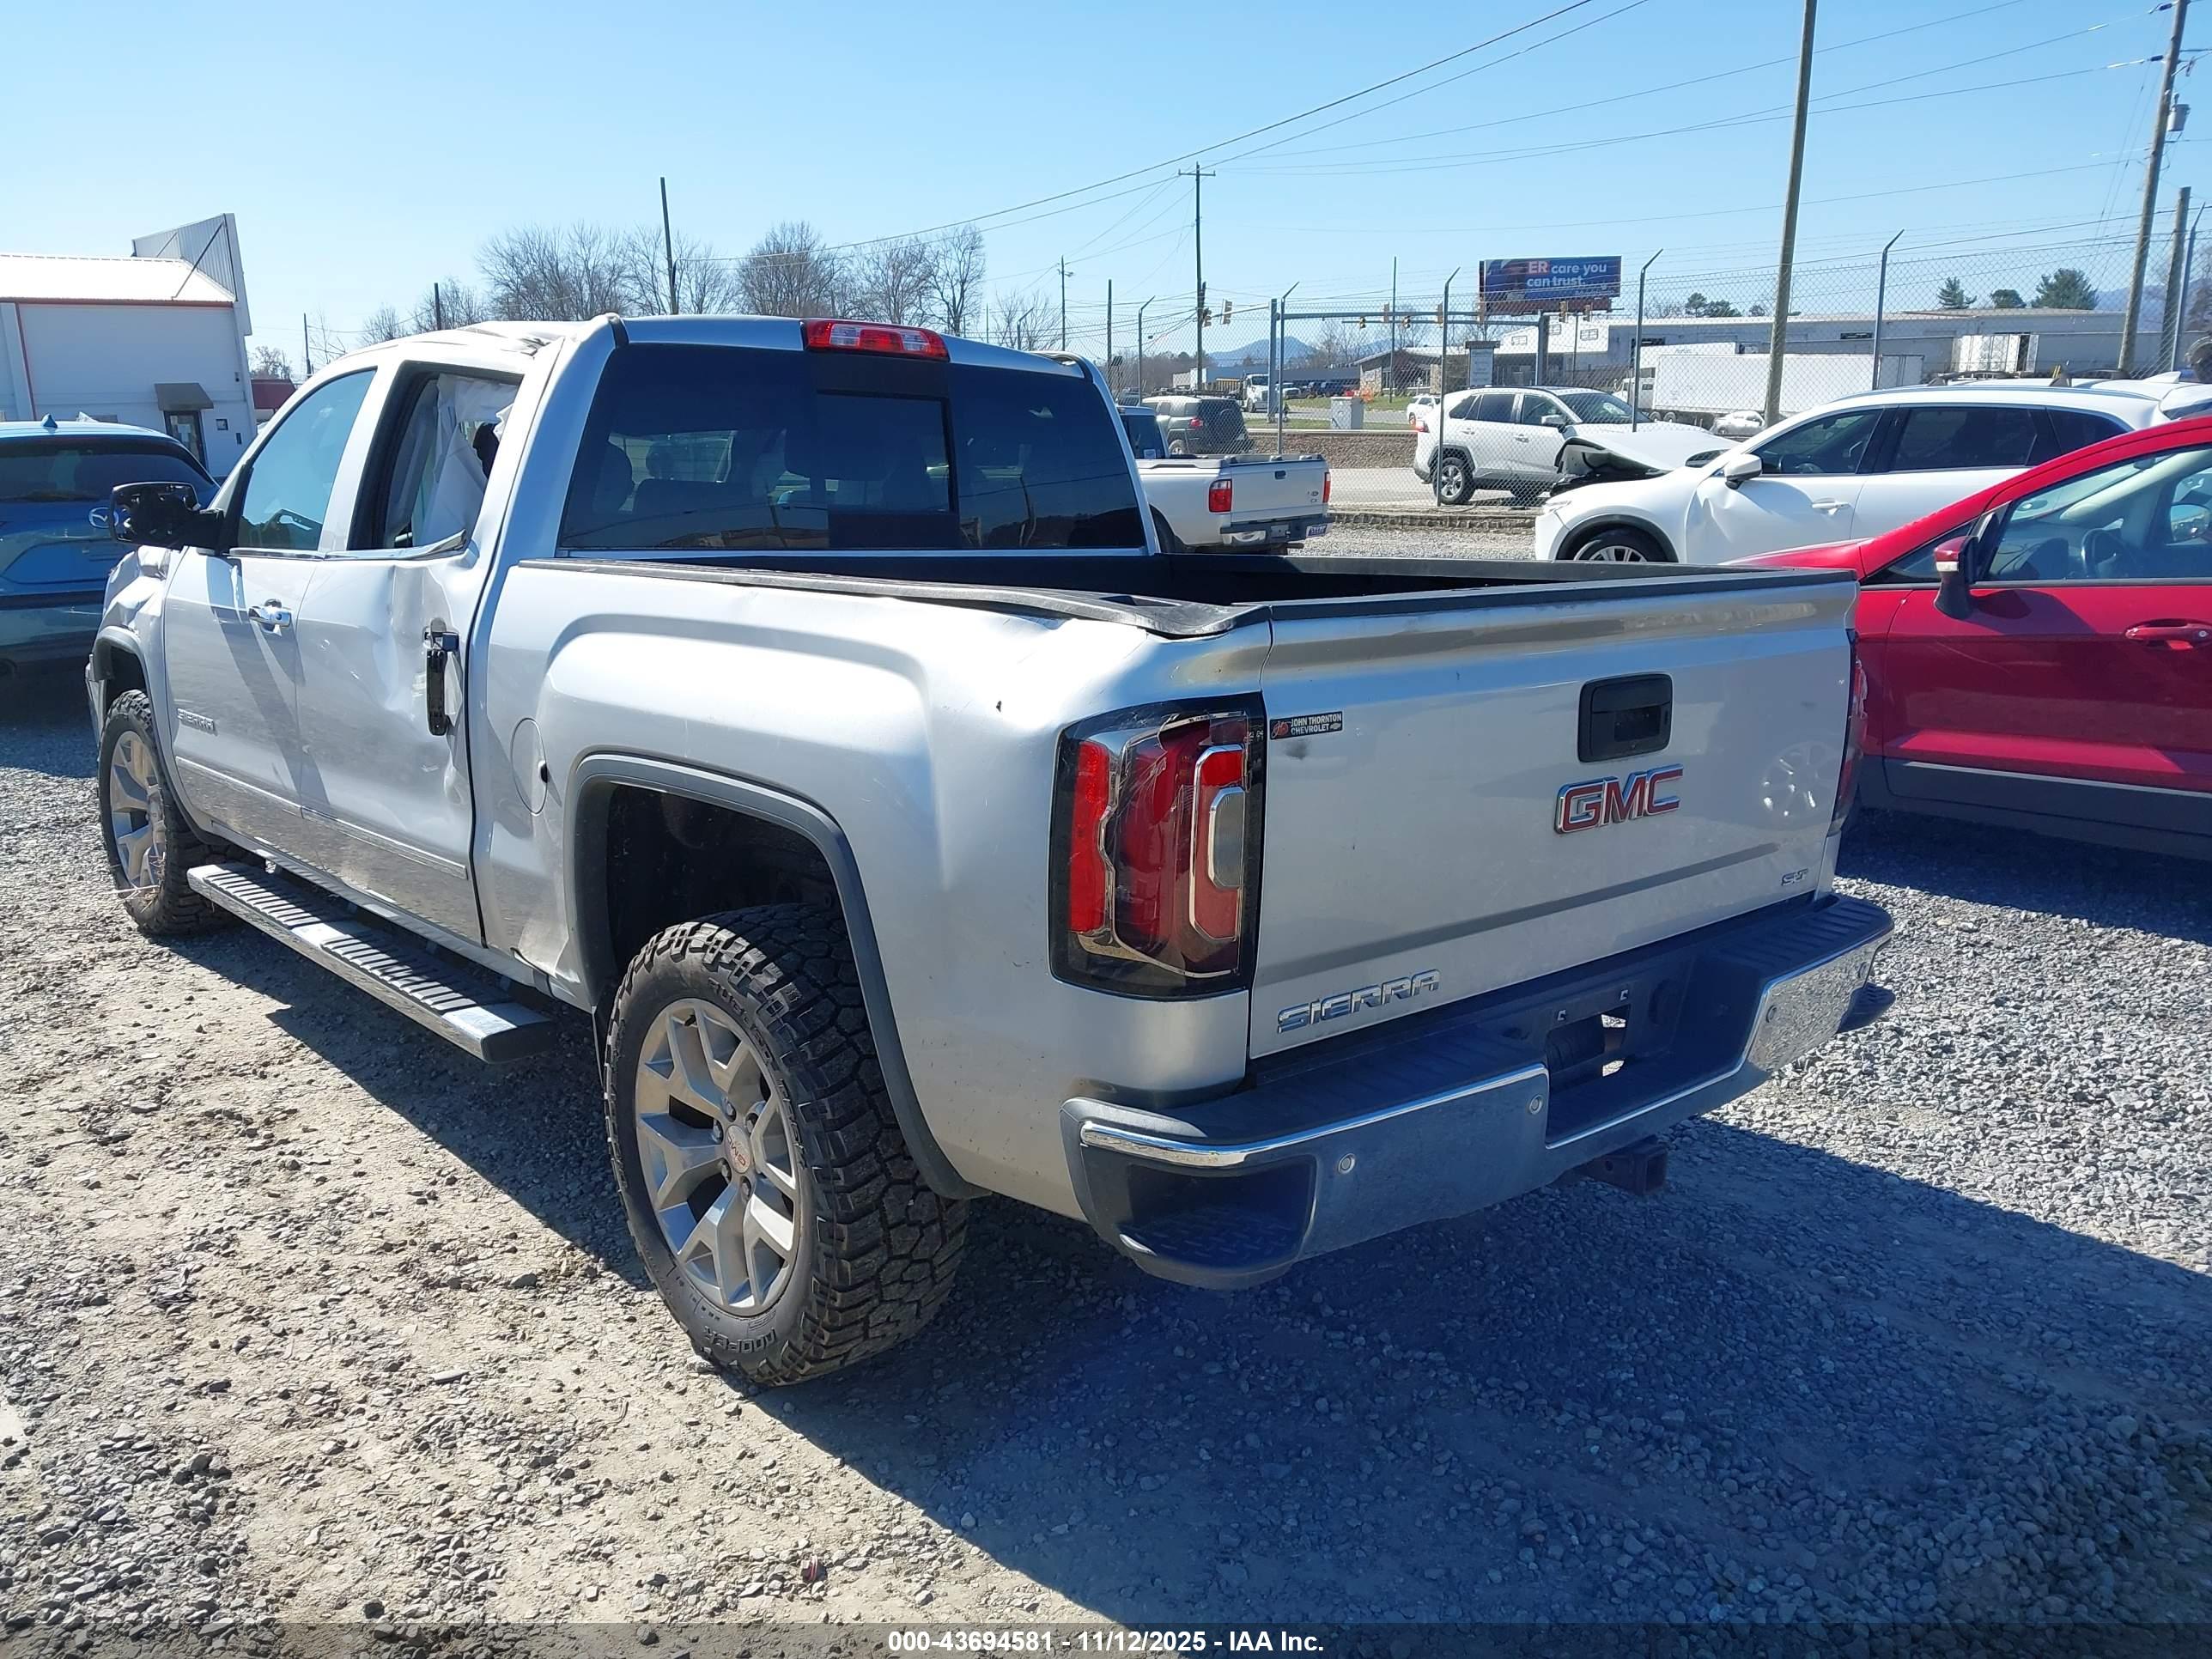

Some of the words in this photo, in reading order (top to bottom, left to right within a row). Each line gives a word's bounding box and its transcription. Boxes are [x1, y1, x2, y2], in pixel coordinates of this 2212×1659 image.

[1528, 260, 1548, 274] ER
[1552, 264, 1580, 274] care
[1583, 263, 1607, 276] you
[1527, 276, 1550, 287] can
[1553, 275, 1586, 286] trust.
[1291, 717, 1308, 727] JOHN
[1308, 713, 1342, 726] THORNTON
[1291, 723, 1330, 735] CHEVROLET
[1554, 763, 1684, 835] GMC
[1277, 969, 1442, 1034] SIERRA
[727, 1133, 746, 1166] GMC
